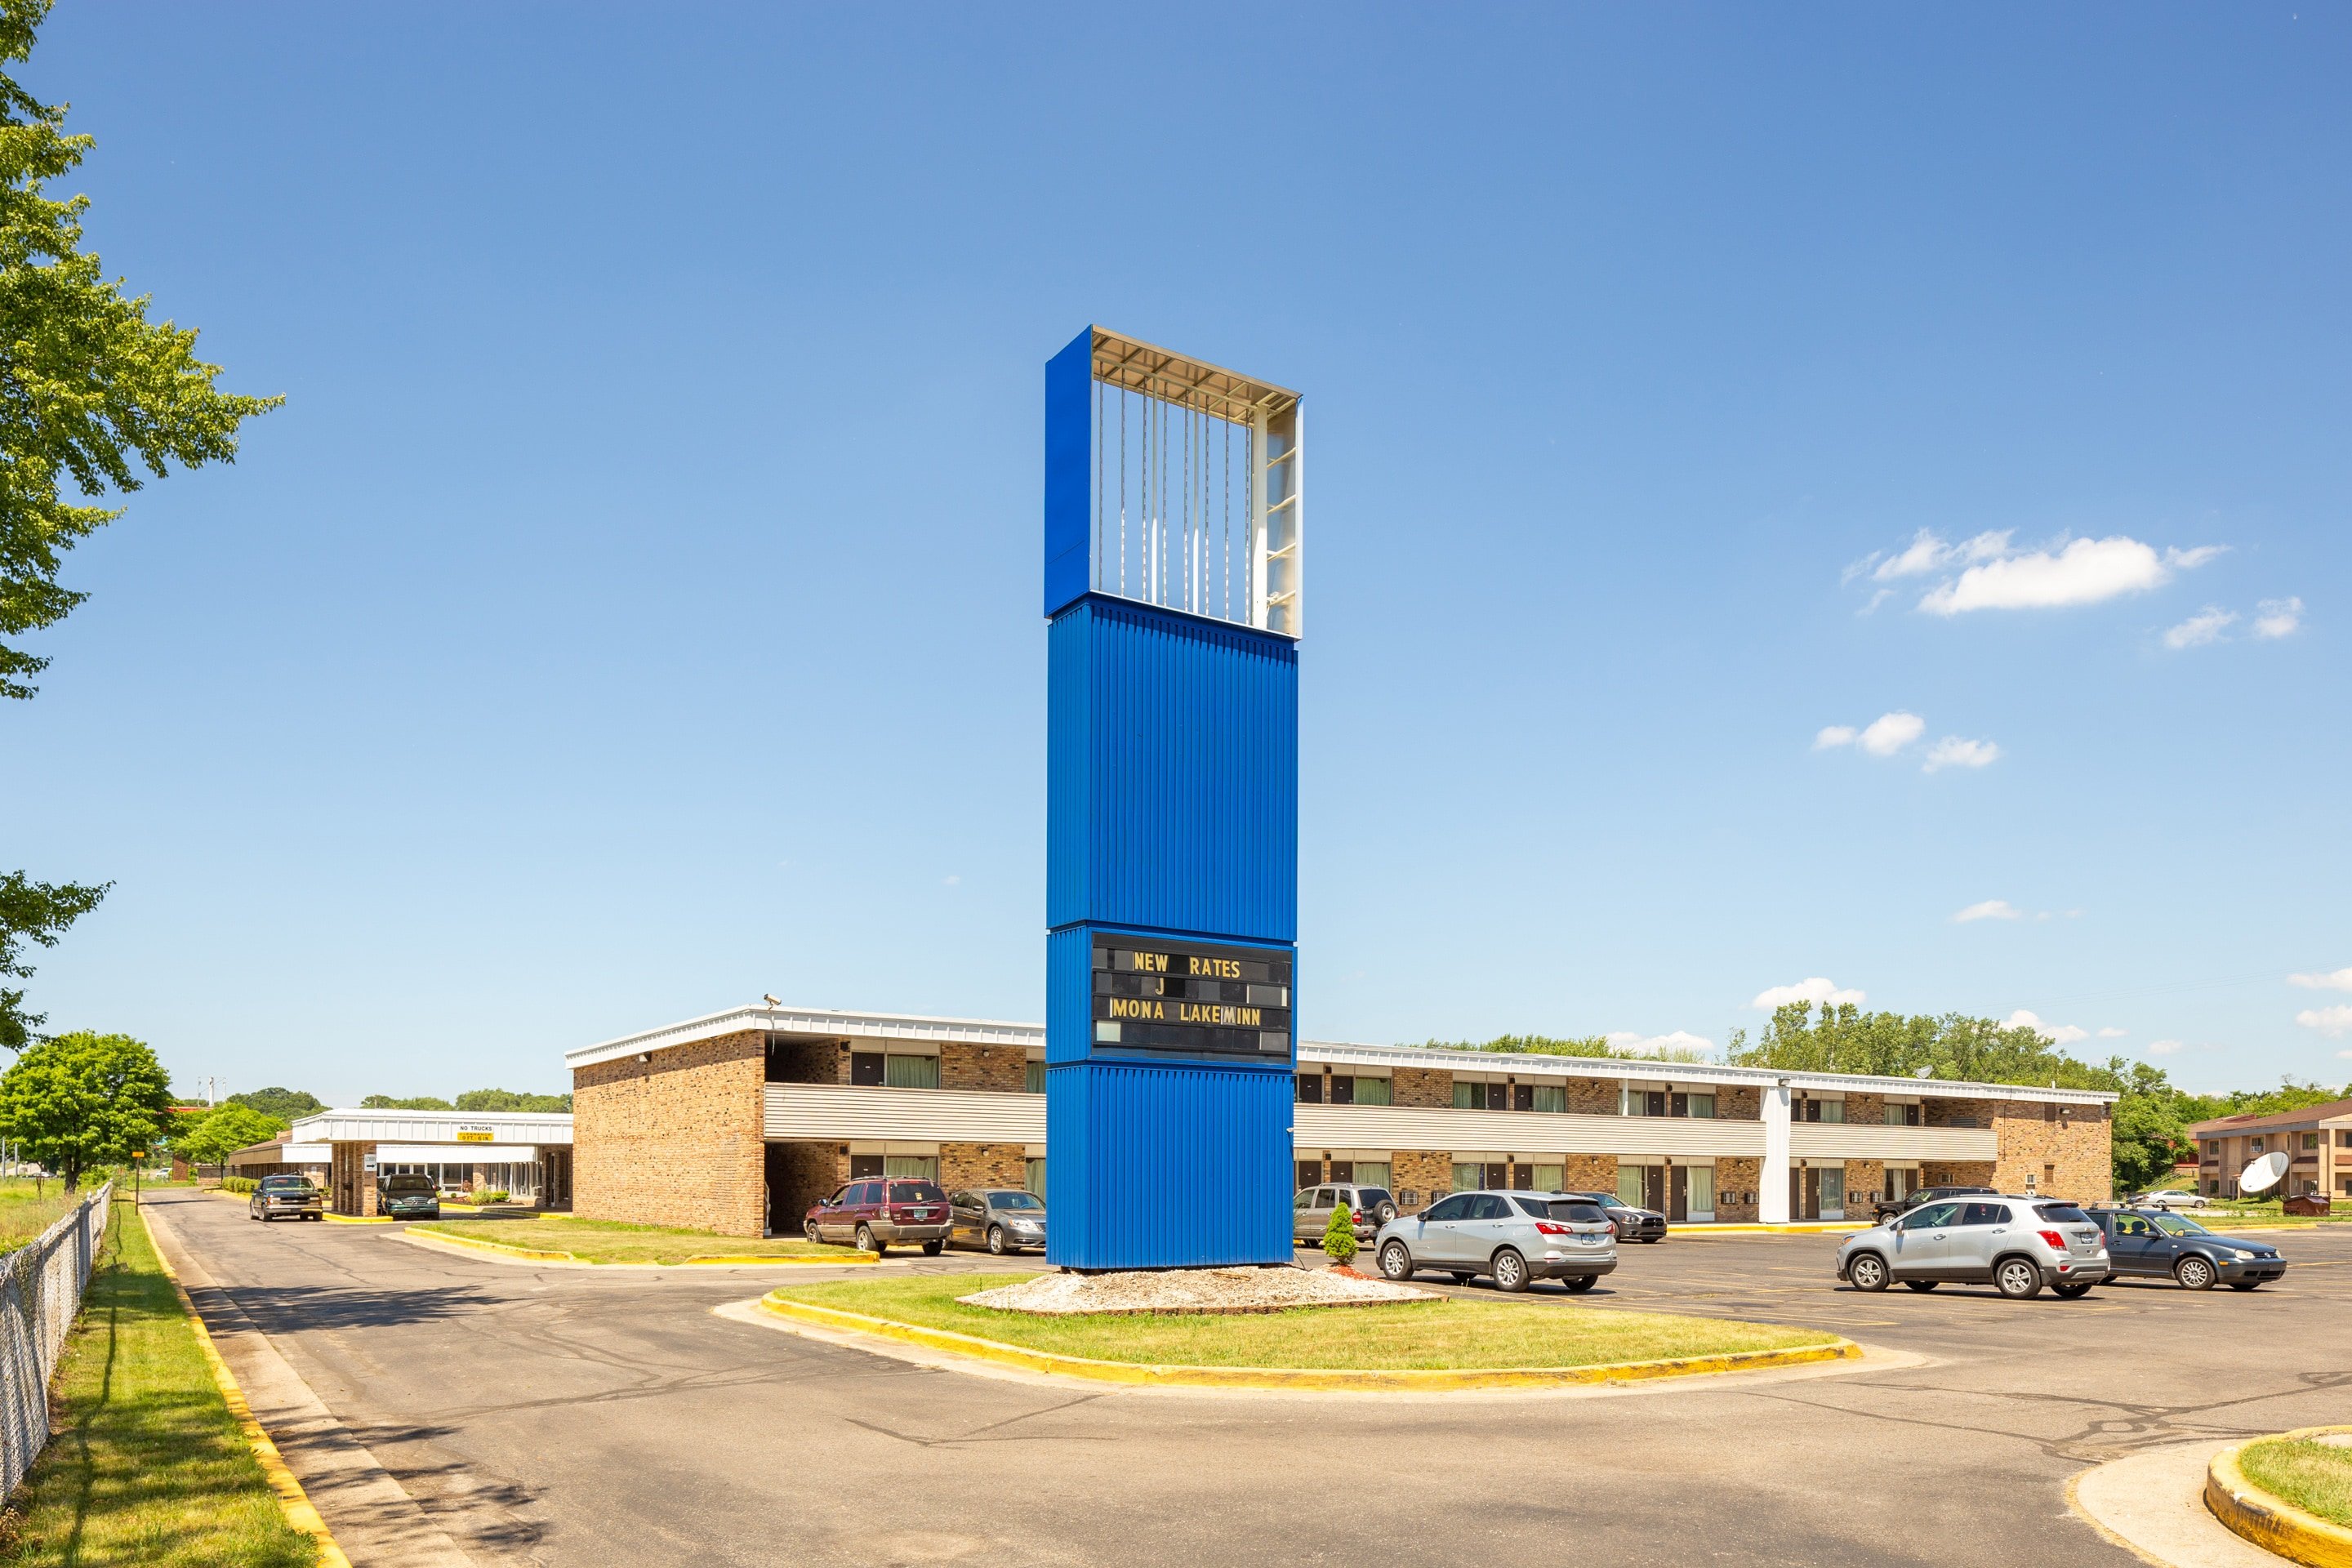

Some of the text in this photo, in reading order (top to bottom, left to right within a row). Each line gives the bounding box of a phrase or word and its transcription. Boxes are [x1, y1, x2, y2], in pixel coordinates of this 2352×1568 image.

[1134, 951, 1241, 978] NEW RATES
[1155, 978, 1165, 996] J
[1112, 998, 1165, 1019] MONA
